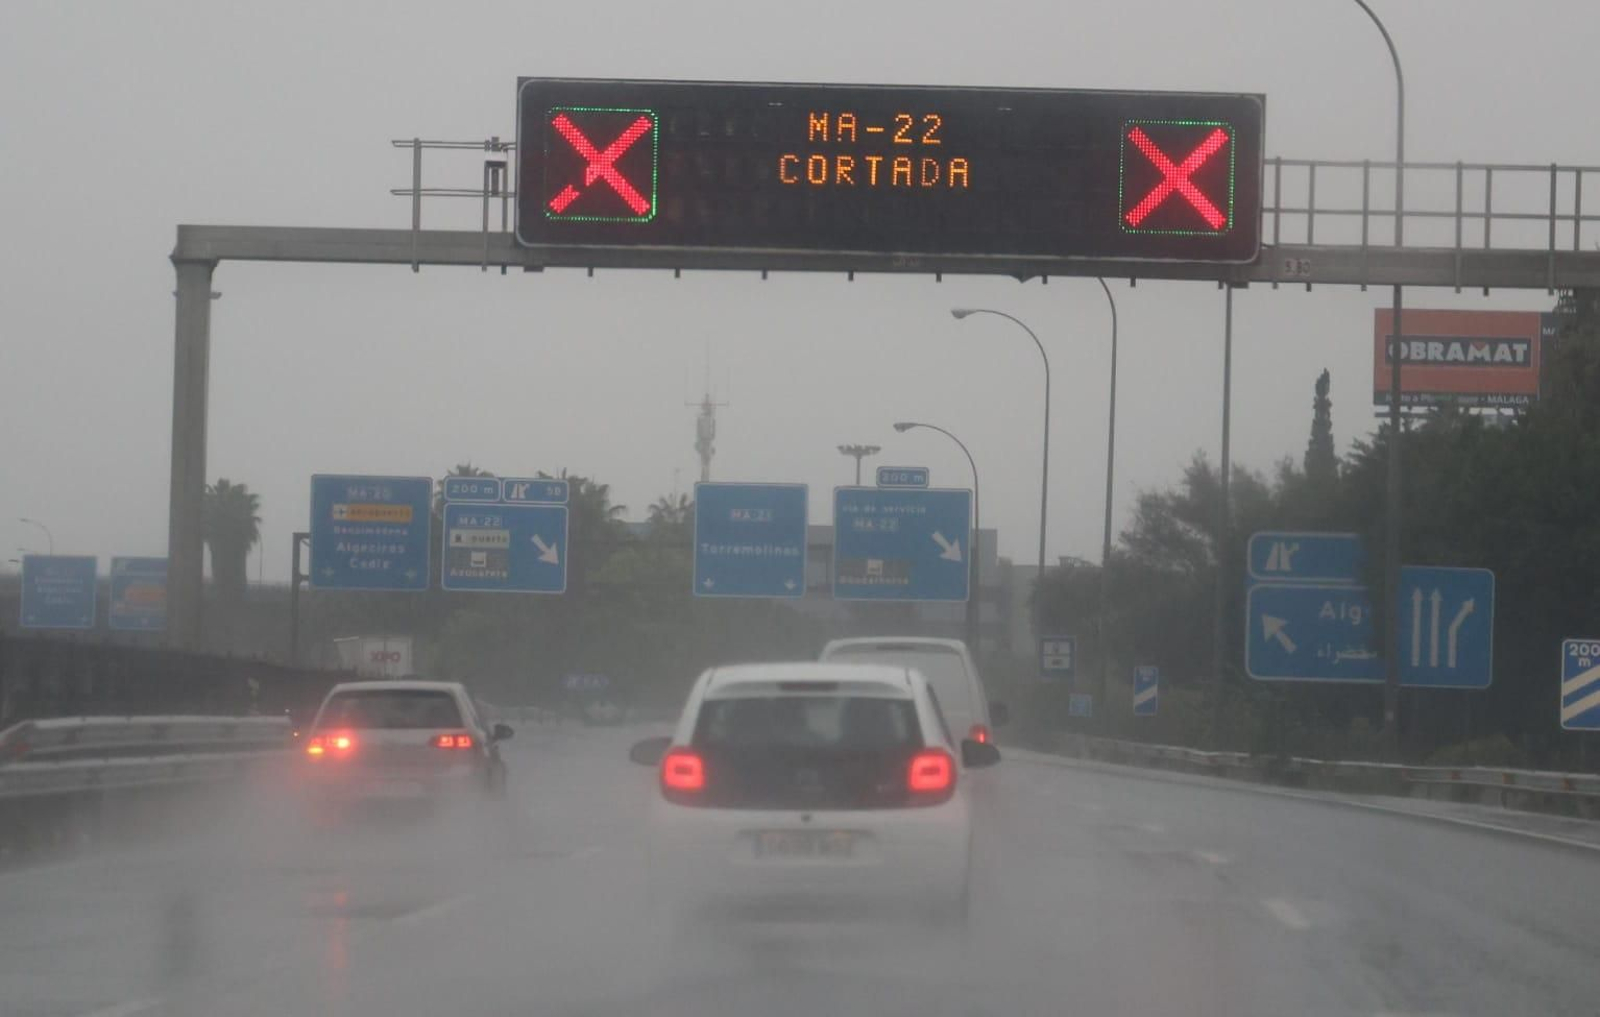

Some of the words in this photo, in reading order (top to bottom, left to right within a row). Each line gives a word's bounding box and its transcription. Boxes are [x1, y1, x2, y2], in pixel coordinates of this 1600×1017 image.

[808, 112, 943, 144] MA-22
[778, 154, 970, 188] CORTADA
[1388, 340, 1528, 363] OBRAMAT
[913, 474, 924, 482] m
[451, 484, 478, 494] 200
[701, 543, 800, 556] Torremolinos
[1569, 643, 1600, 657] 200
[1578, 658, 1591, 667] m
